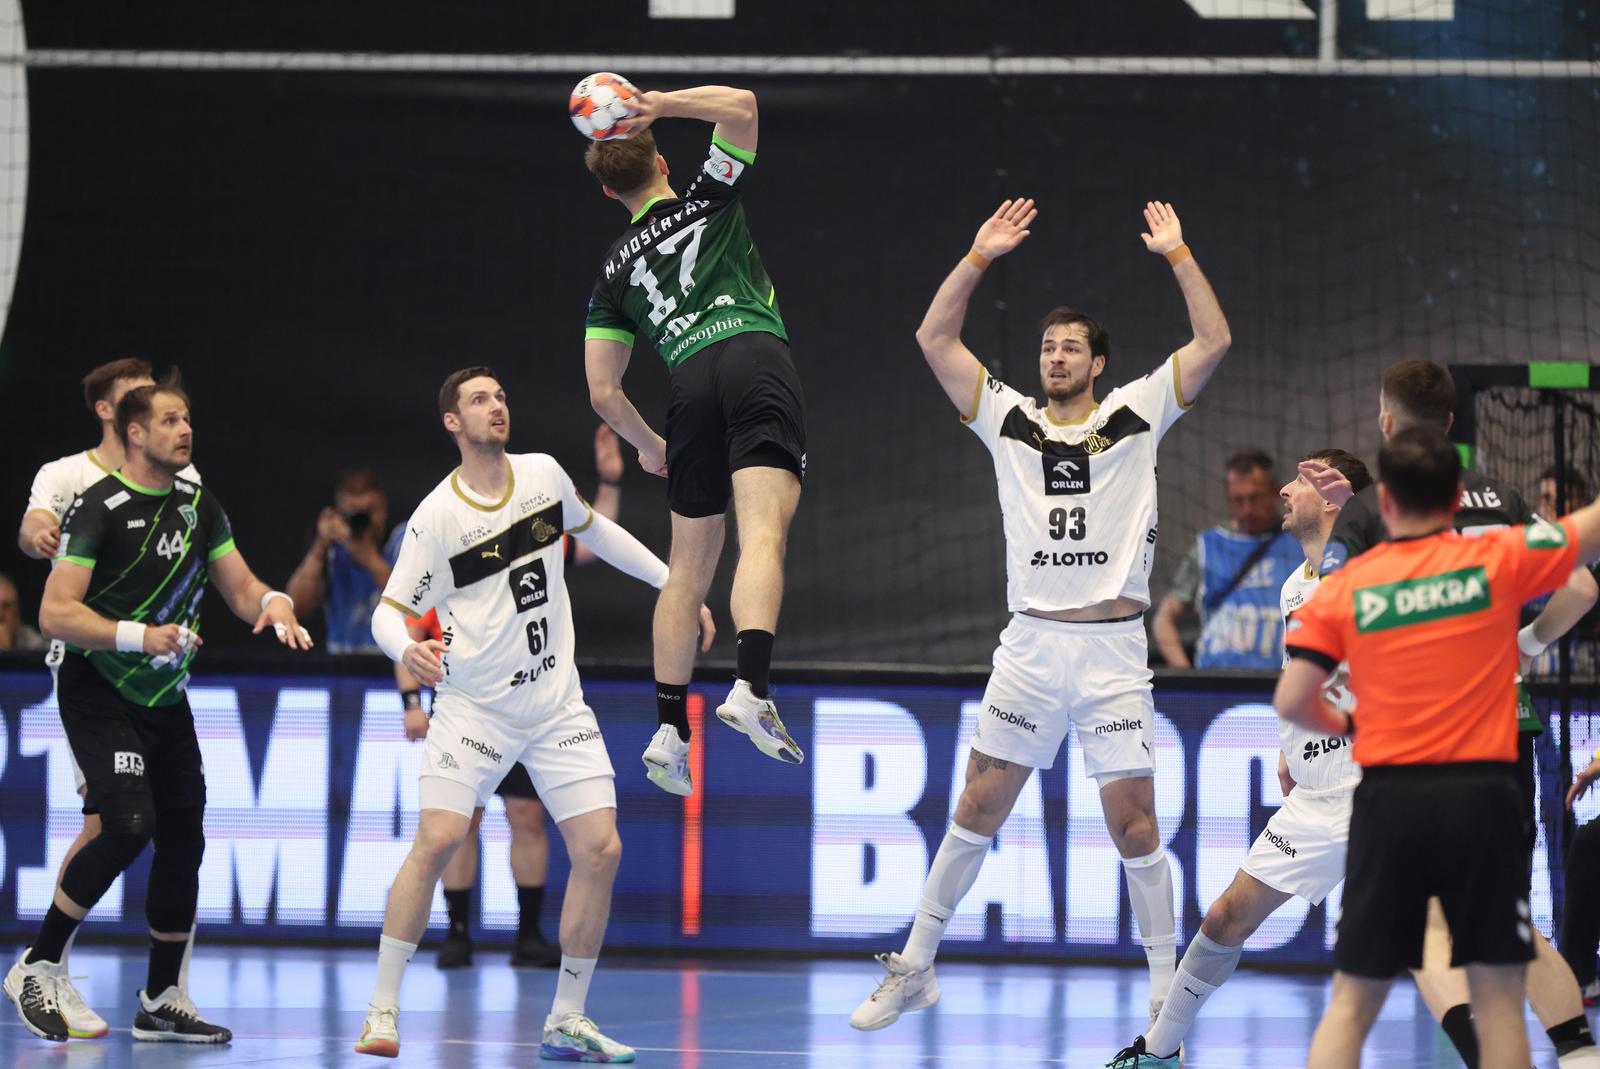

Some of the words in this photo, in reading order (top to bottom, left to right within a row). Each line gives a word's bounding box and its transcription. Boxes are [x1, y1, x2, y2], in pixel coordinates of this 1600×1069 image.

[629, 217, 708, 327] 17
[1051, 480, 1084, 490] ORLEN
[1049, 506, 1087, 541] 93
[156, 530, 187, 560] 44
[1052, 551, 1109, 567] LOTTO
[521, 589, 545, 605] ORLEN
[1395, 576, 1485, 616] DEKRA
[526, 616, 548, 656] 61
[657, 692, 680, 701] JAKO
[988, 704, 1038, 734] mobilet
[1095, 719, 1143, 736] mobilet
[461, 736, 503, 765] mobilet
[1264, 828, 1298, 859] mobilet
